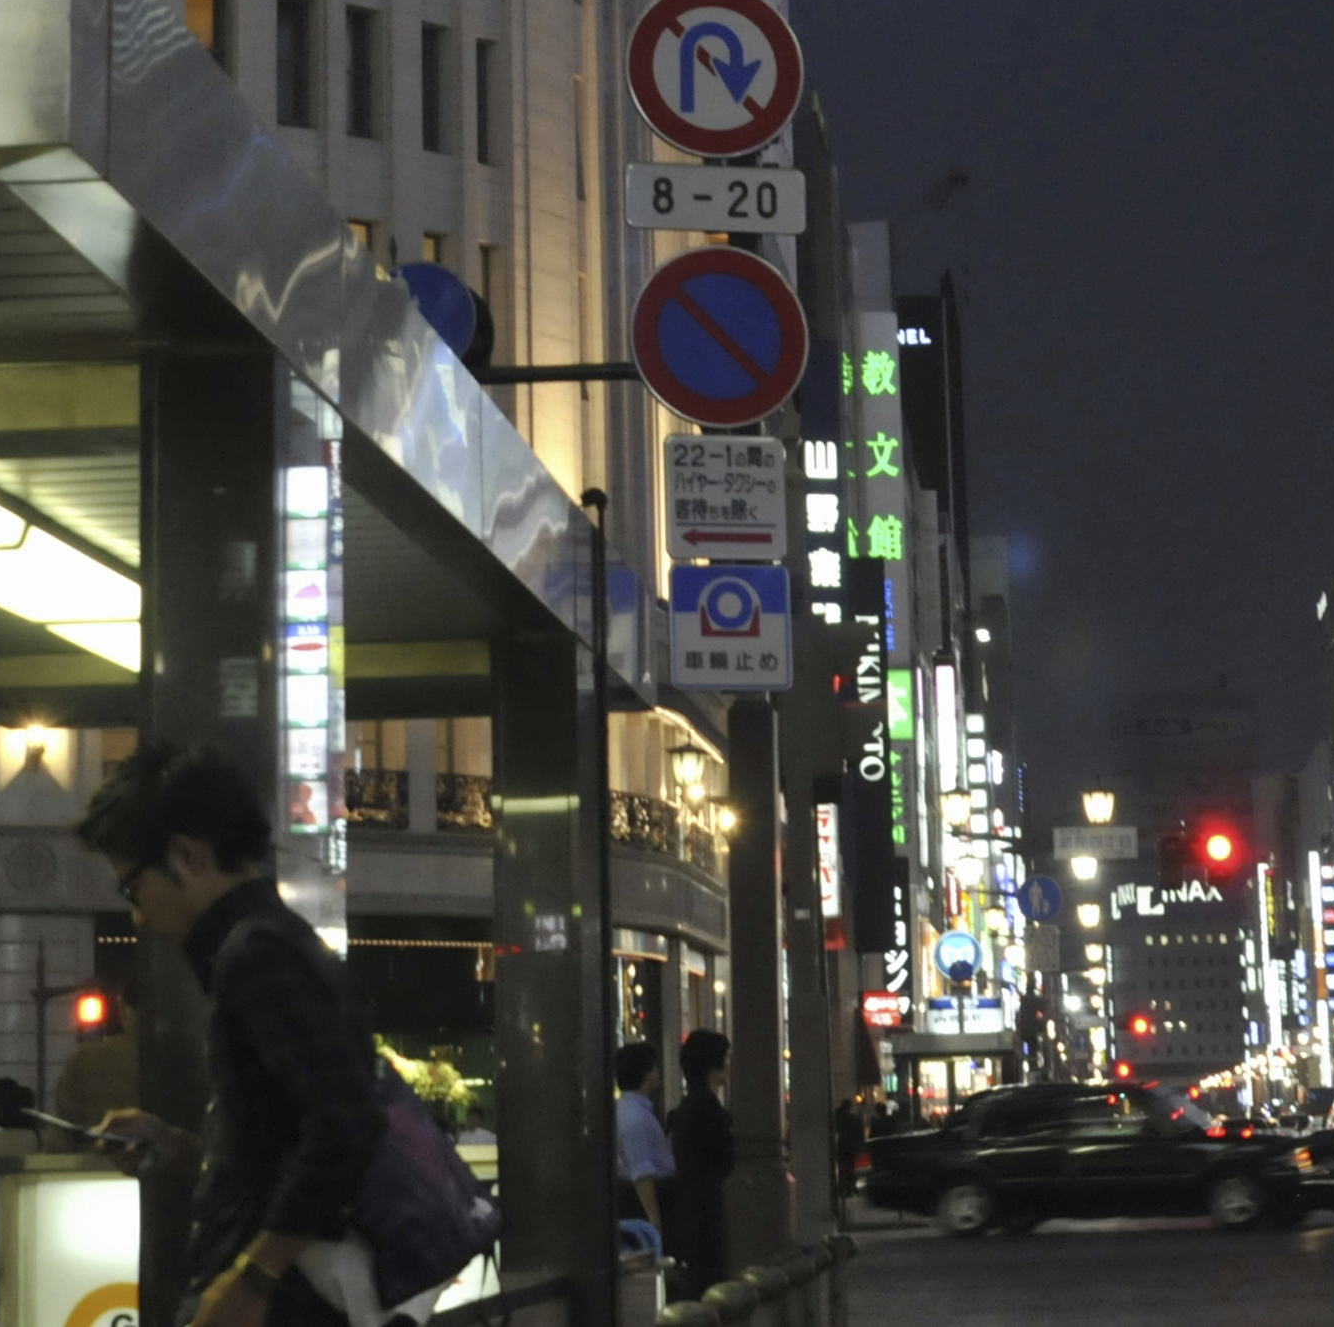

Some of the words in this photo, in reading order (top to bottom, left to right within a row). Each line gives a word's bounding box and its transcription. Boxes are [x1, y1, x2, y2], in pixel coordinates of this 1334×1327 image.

[860, 351, 904, 562] 教文館
[685, 650, 778, 673] 車輪止め
